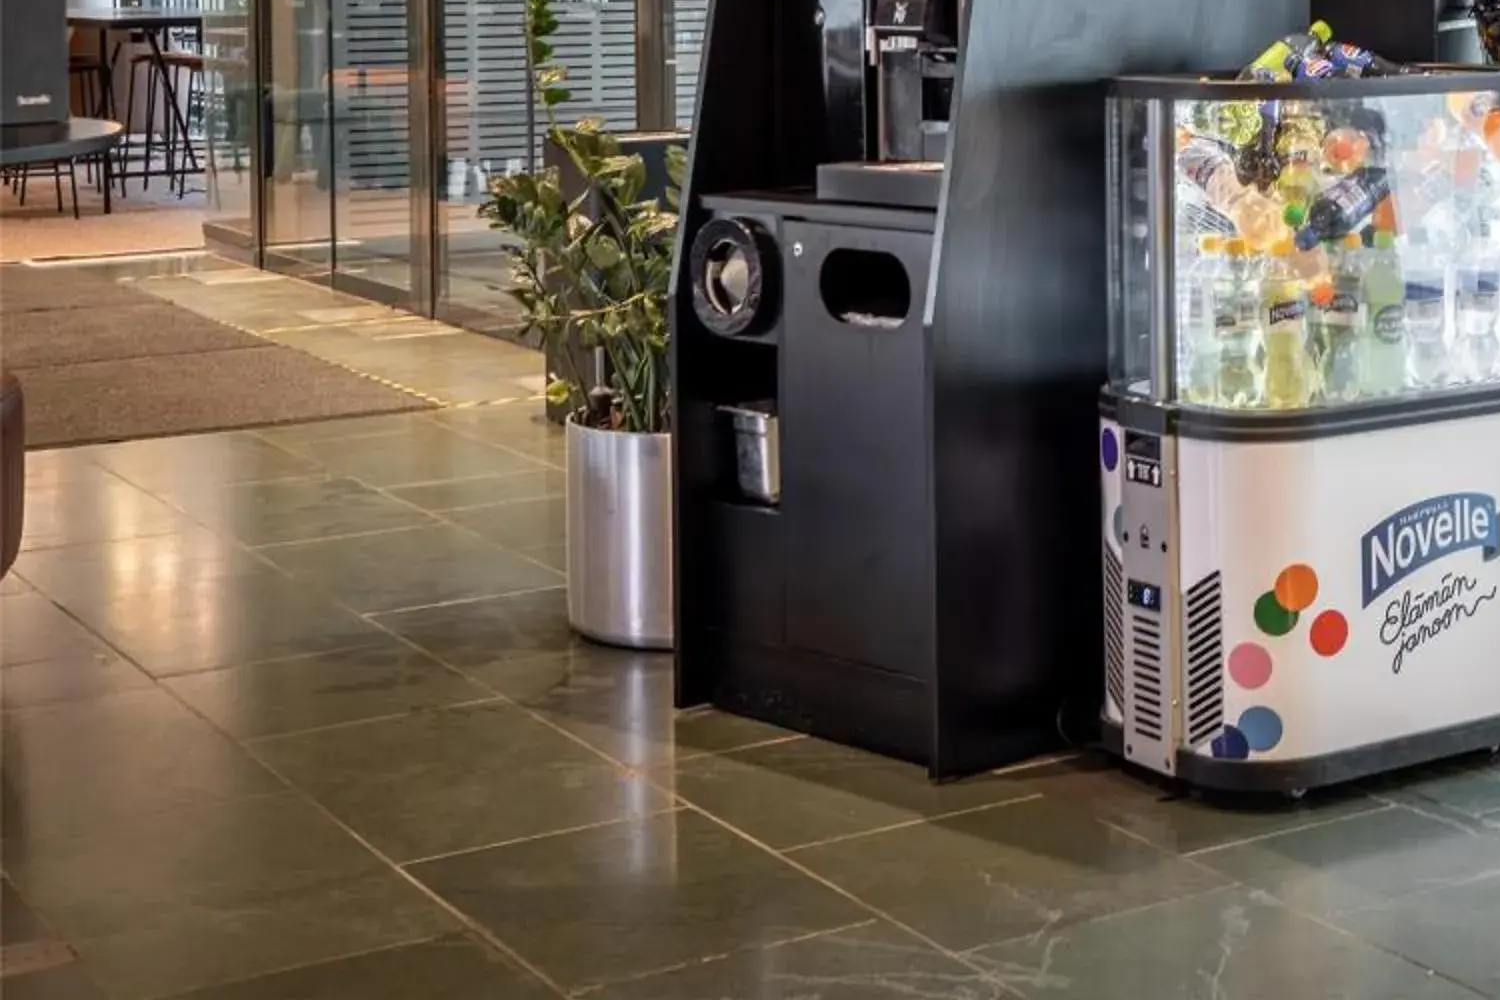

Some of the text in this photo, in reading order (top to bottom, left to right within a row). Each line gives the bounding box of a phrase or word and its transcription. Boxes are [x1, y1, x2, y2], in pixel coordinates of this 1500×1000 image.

[1371, 497, 1490, 591] Novelle
[1380, 571, 1477, 645] Elämän
[1392, 584, 1497, 675] janoon
